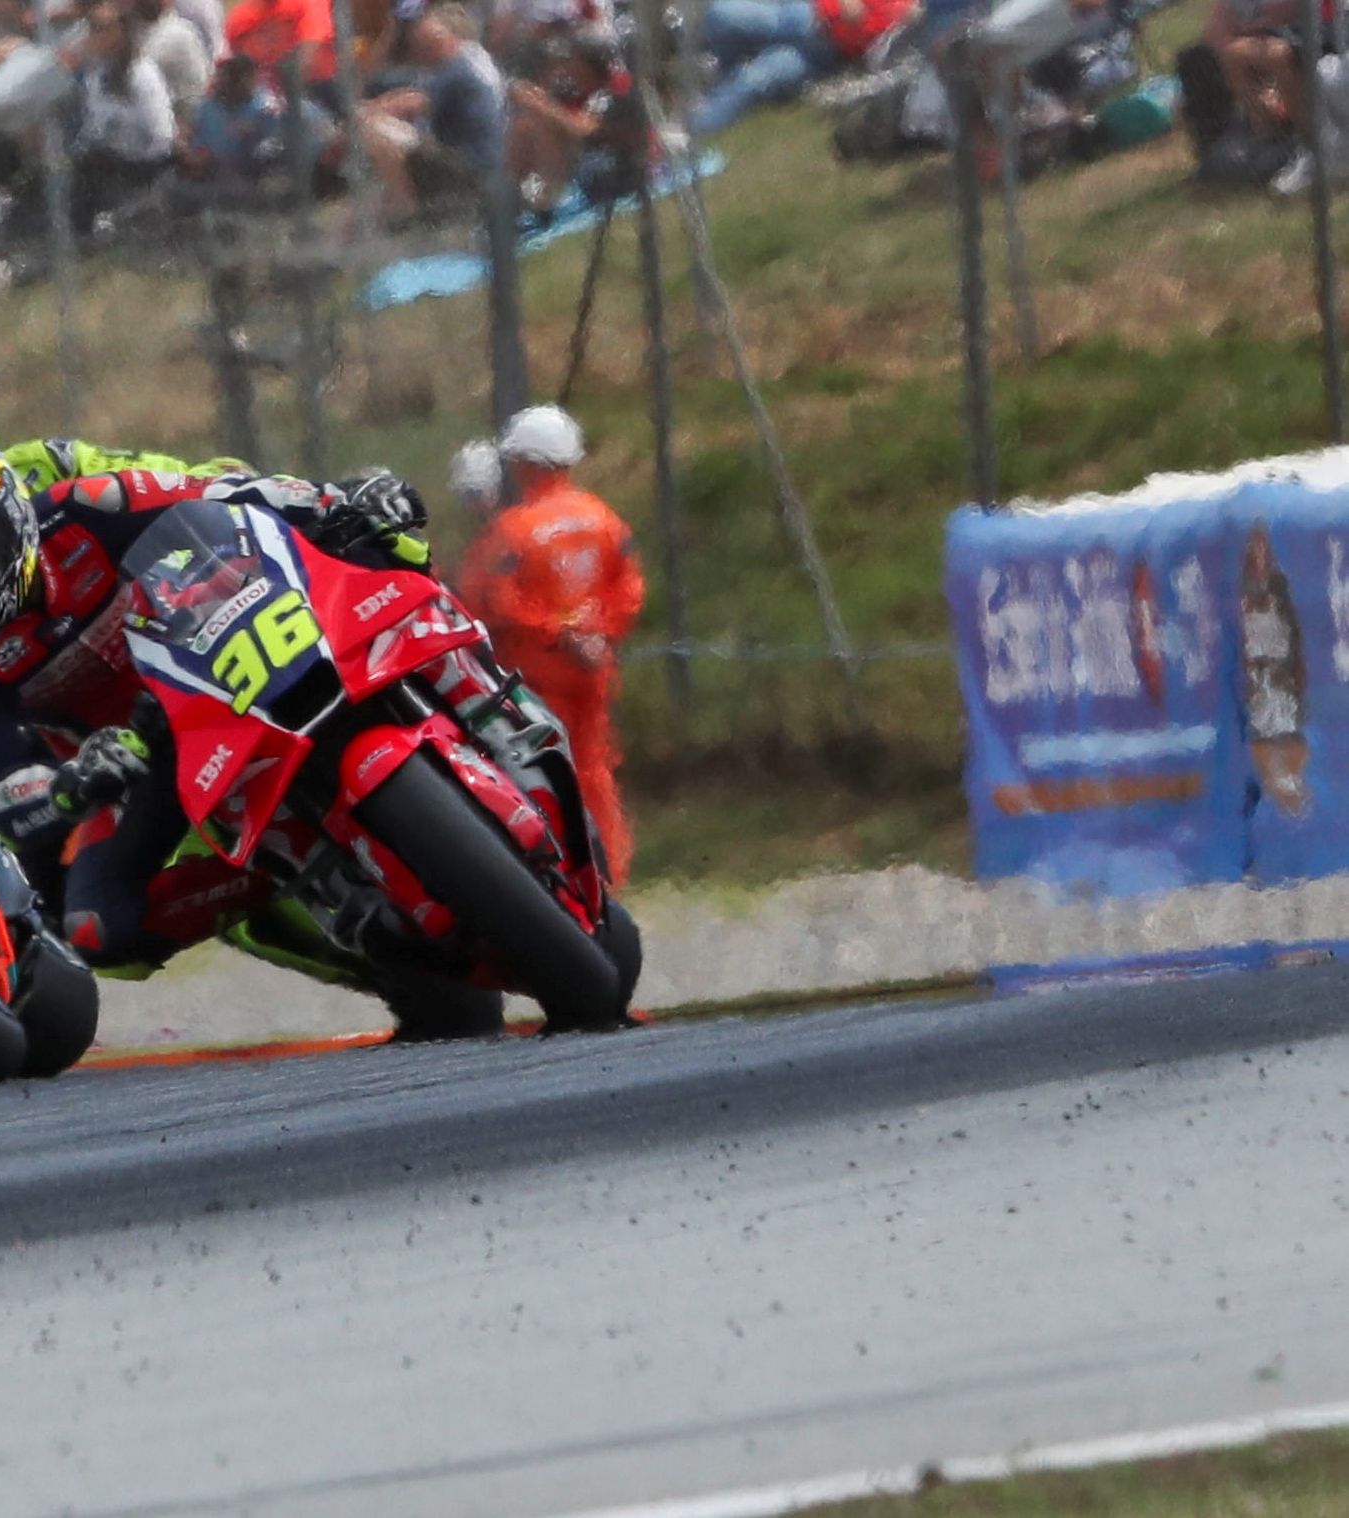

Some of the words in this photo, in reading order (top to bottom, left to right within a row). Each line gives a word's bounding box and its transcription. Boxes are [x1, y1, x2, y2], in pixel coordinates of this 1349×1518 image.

[205, 583, 266, 636] Castrol
[352, 581, 403, 621] IBM
[211, 589, 323, 716] 36
[195, 744, 234, 791] IBM
